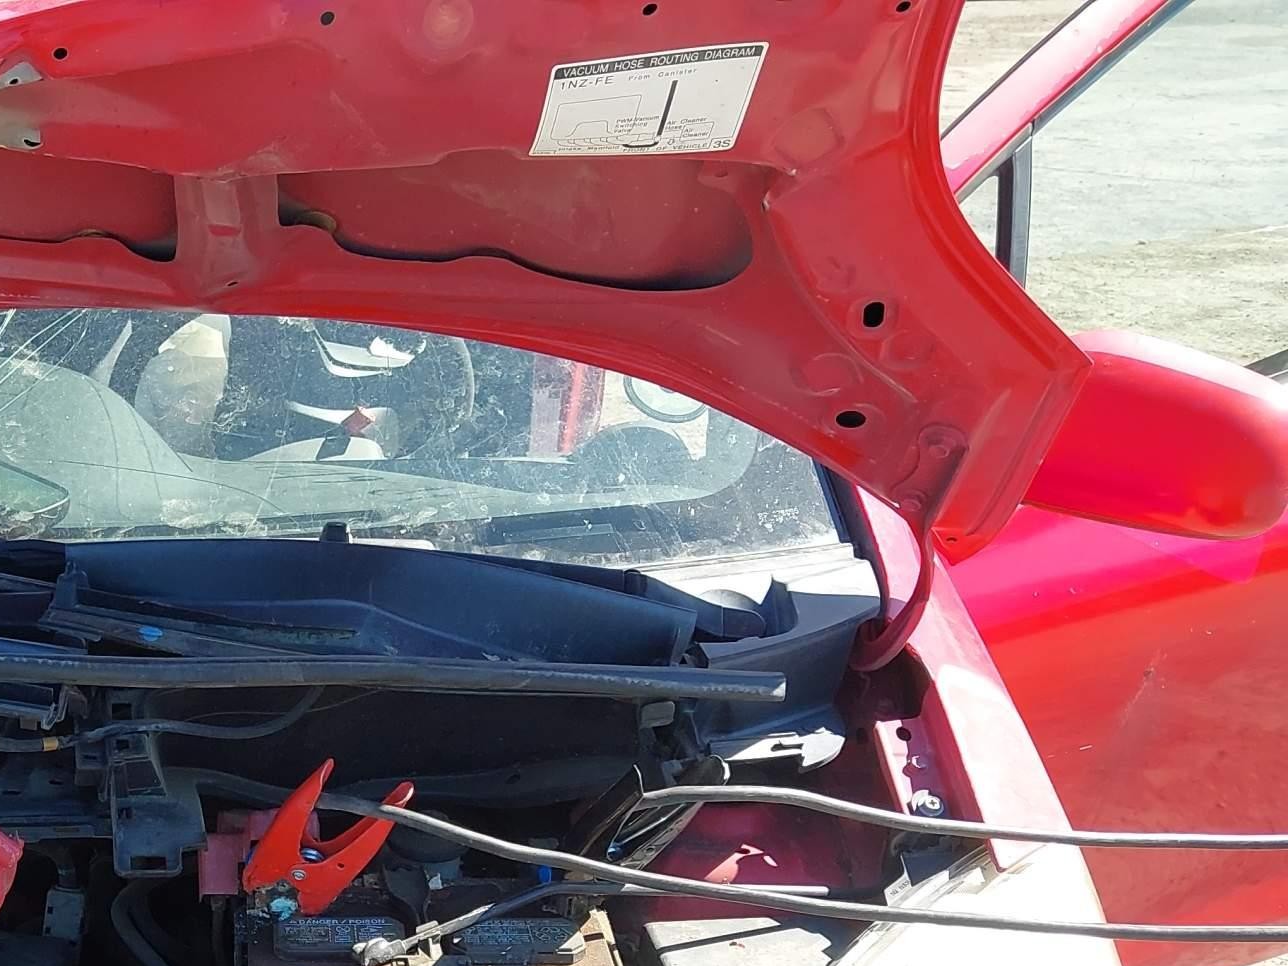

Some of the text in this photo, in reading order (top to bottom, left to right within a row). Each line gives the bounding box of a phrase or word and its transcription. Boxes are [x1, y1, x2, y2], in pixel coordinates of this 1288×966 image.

[563, 47, 756, 78] VACUUM HOSE ROUTING DIAGRAM
[657, 68, 698, 78] Canister
[561, 75, 615, 90] 1NZ-FE
[672, 142, 708, 150] VEHICLE
[712, 139, 732, 149] 3S
